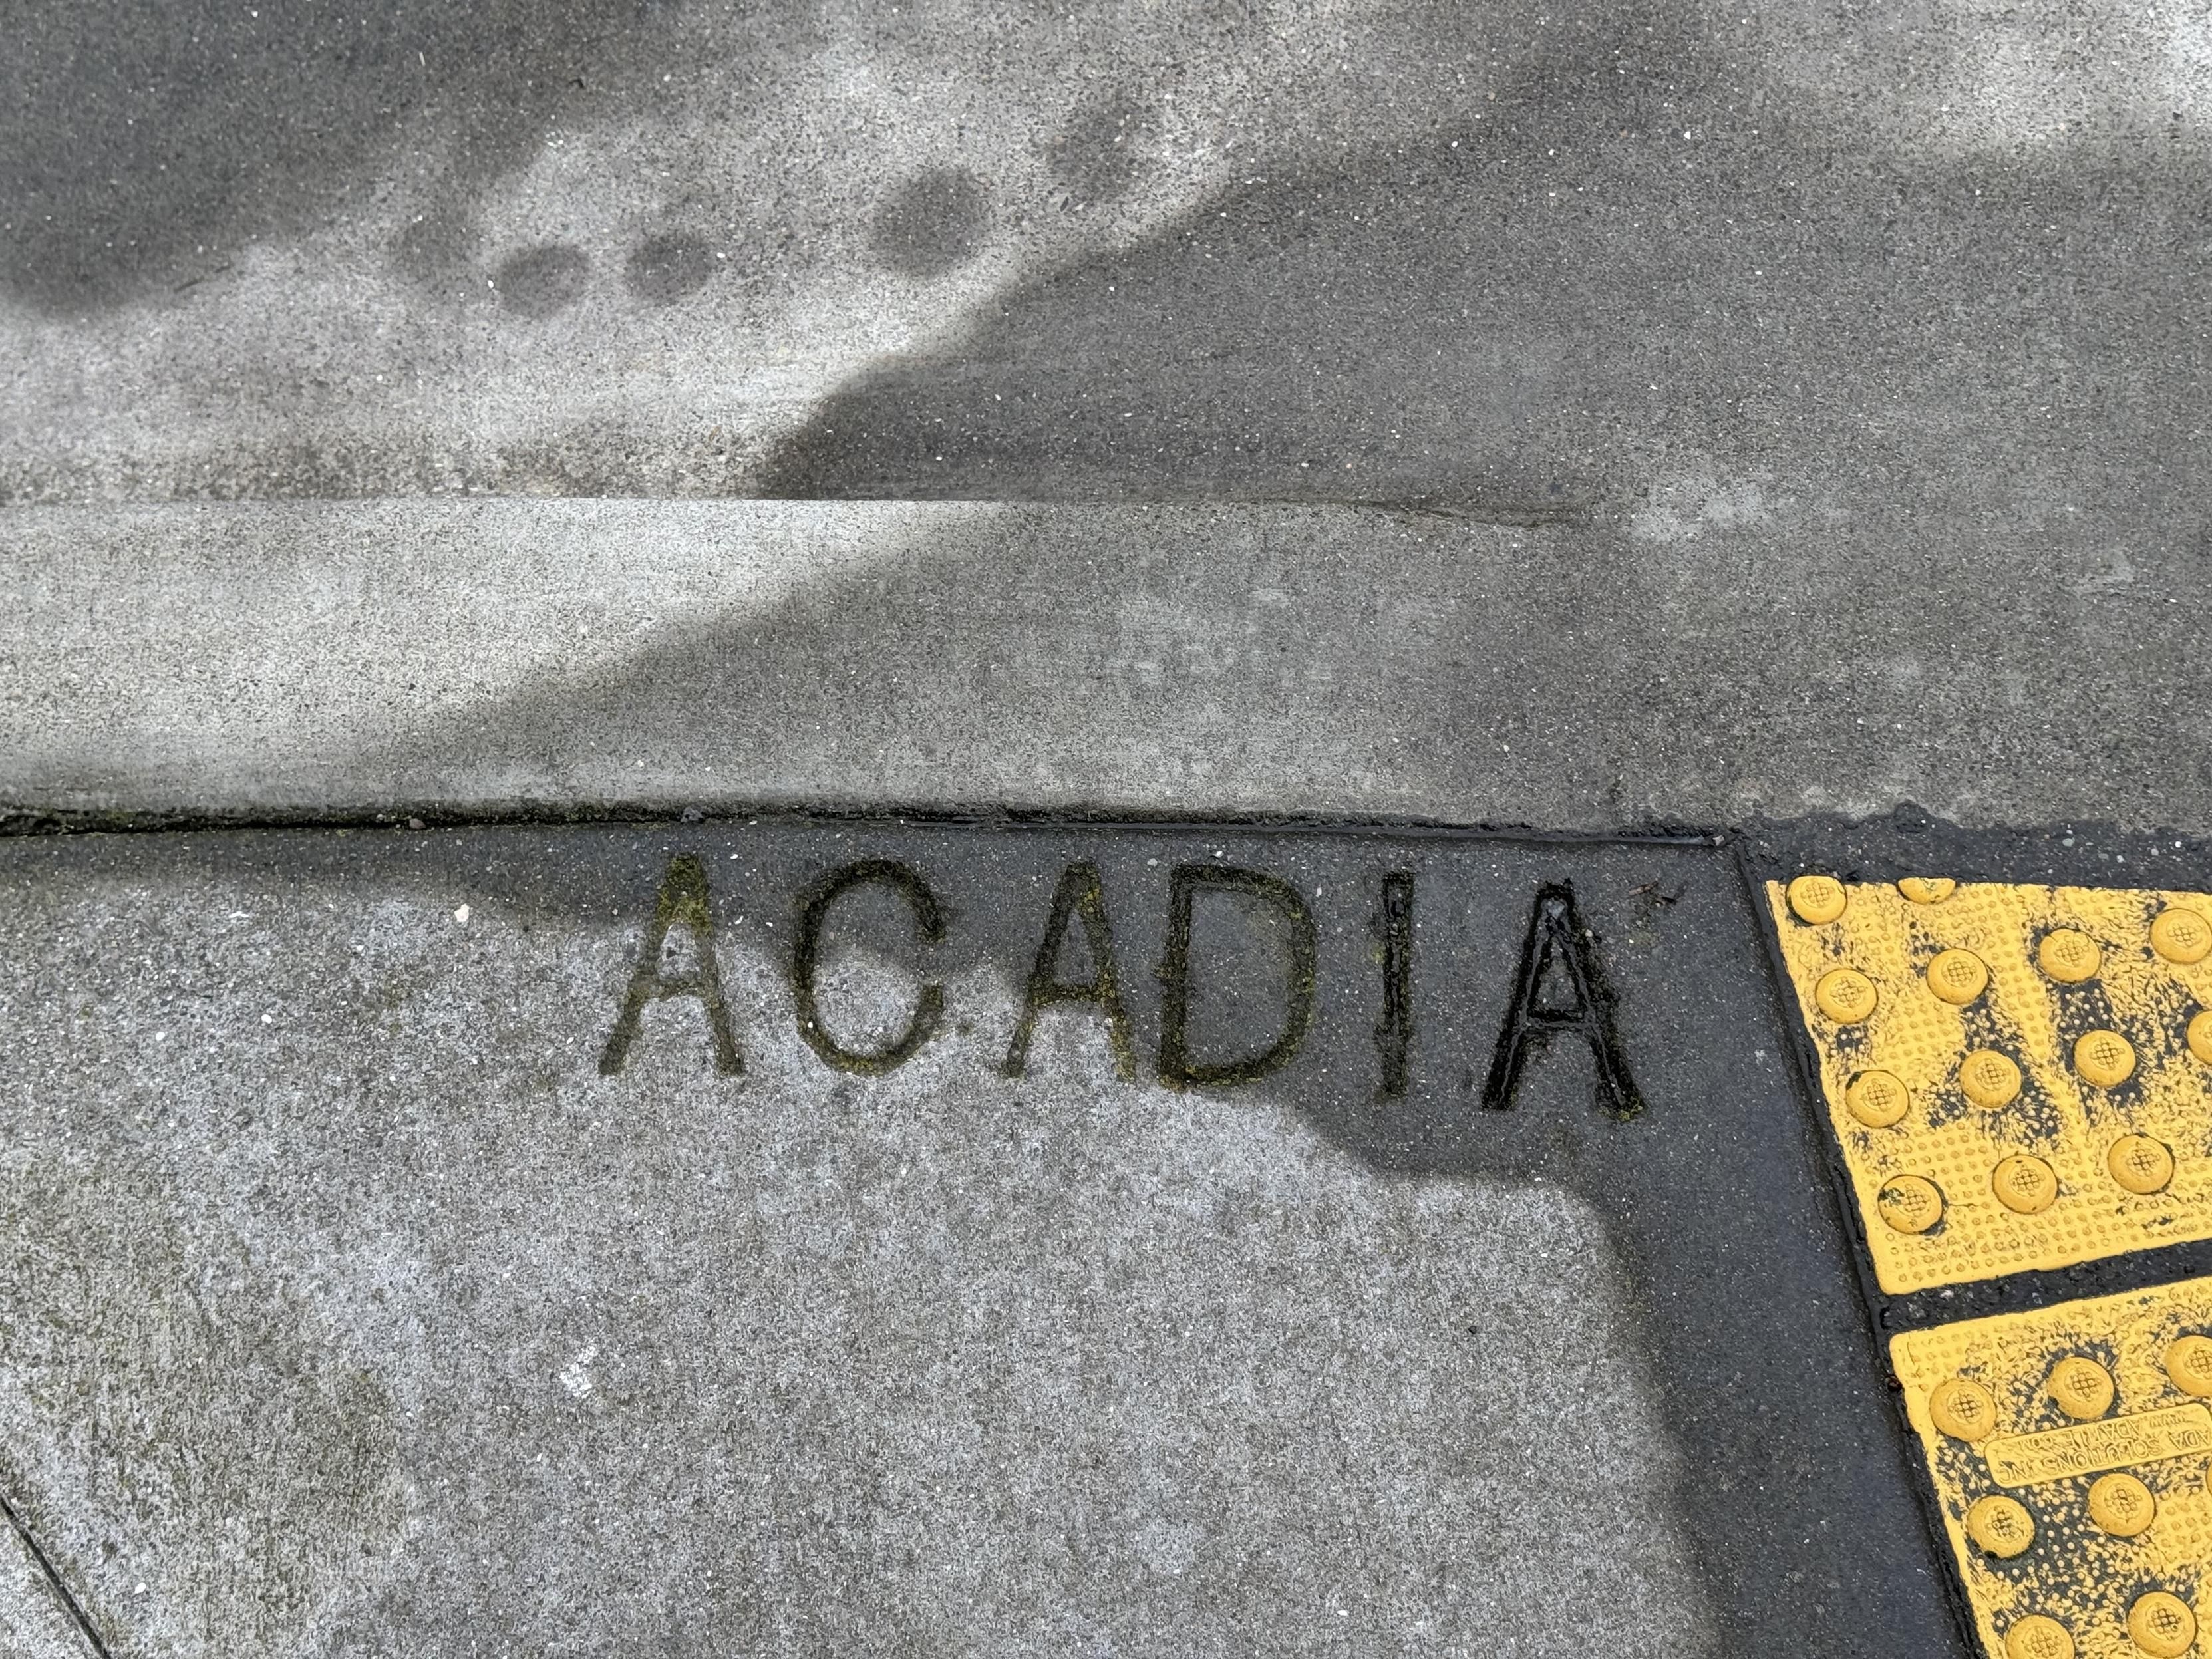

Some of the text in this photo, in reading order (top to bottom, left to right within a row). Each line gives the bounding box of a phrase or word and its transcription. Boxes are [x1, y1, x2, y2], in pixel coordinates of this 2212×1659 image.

[599, 854, 1646, 1122] ACADIA
[2041, 1437, 2163, 1474] SOLUTIONS
[2169, 1430, 2212, 1451] ADA
